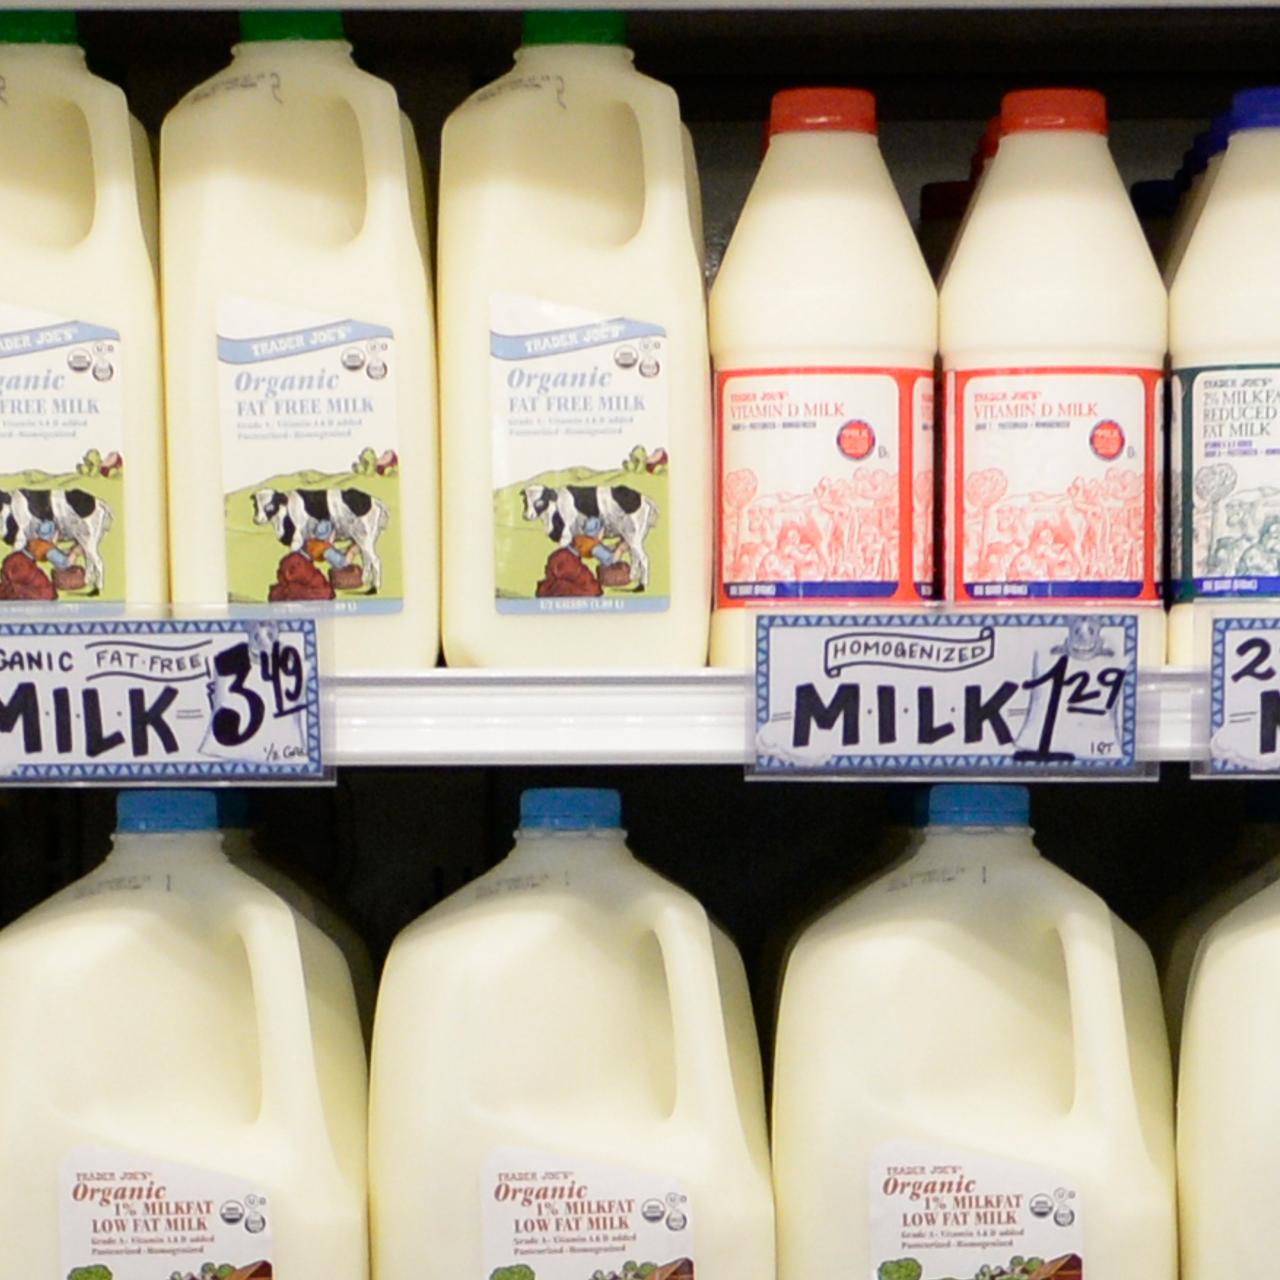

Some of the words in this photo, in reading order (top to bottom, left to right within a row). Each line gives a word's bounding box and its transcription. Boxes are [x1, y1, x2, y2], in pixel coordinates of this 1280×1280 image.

[0, 399, 50, 414] FREE
[53, 398, 100, 414] MILK
[973, 403, 1036, 419] VITAMIN
[1041, 403, 1054, 417] D
[1058, 403, 1098, 417] MILK
[1202, 406, 1278, 422] REDUCED
[1203, 423, 1226, 438] FAT
[1229, 422, 1272, 437] MILK
[833, 639, 987, 664] HOMOGENIZED
[72, 1181, 167, 1207] Organic
[114, 1202, 138, 1217] 1%
[143, 1200, 214, 1216] MILKFAT
[92, 1219, 129, 1234] LOW
[133, 1218, 162, 1232] FAT
[166, 1217, 208, 1231] MILK
